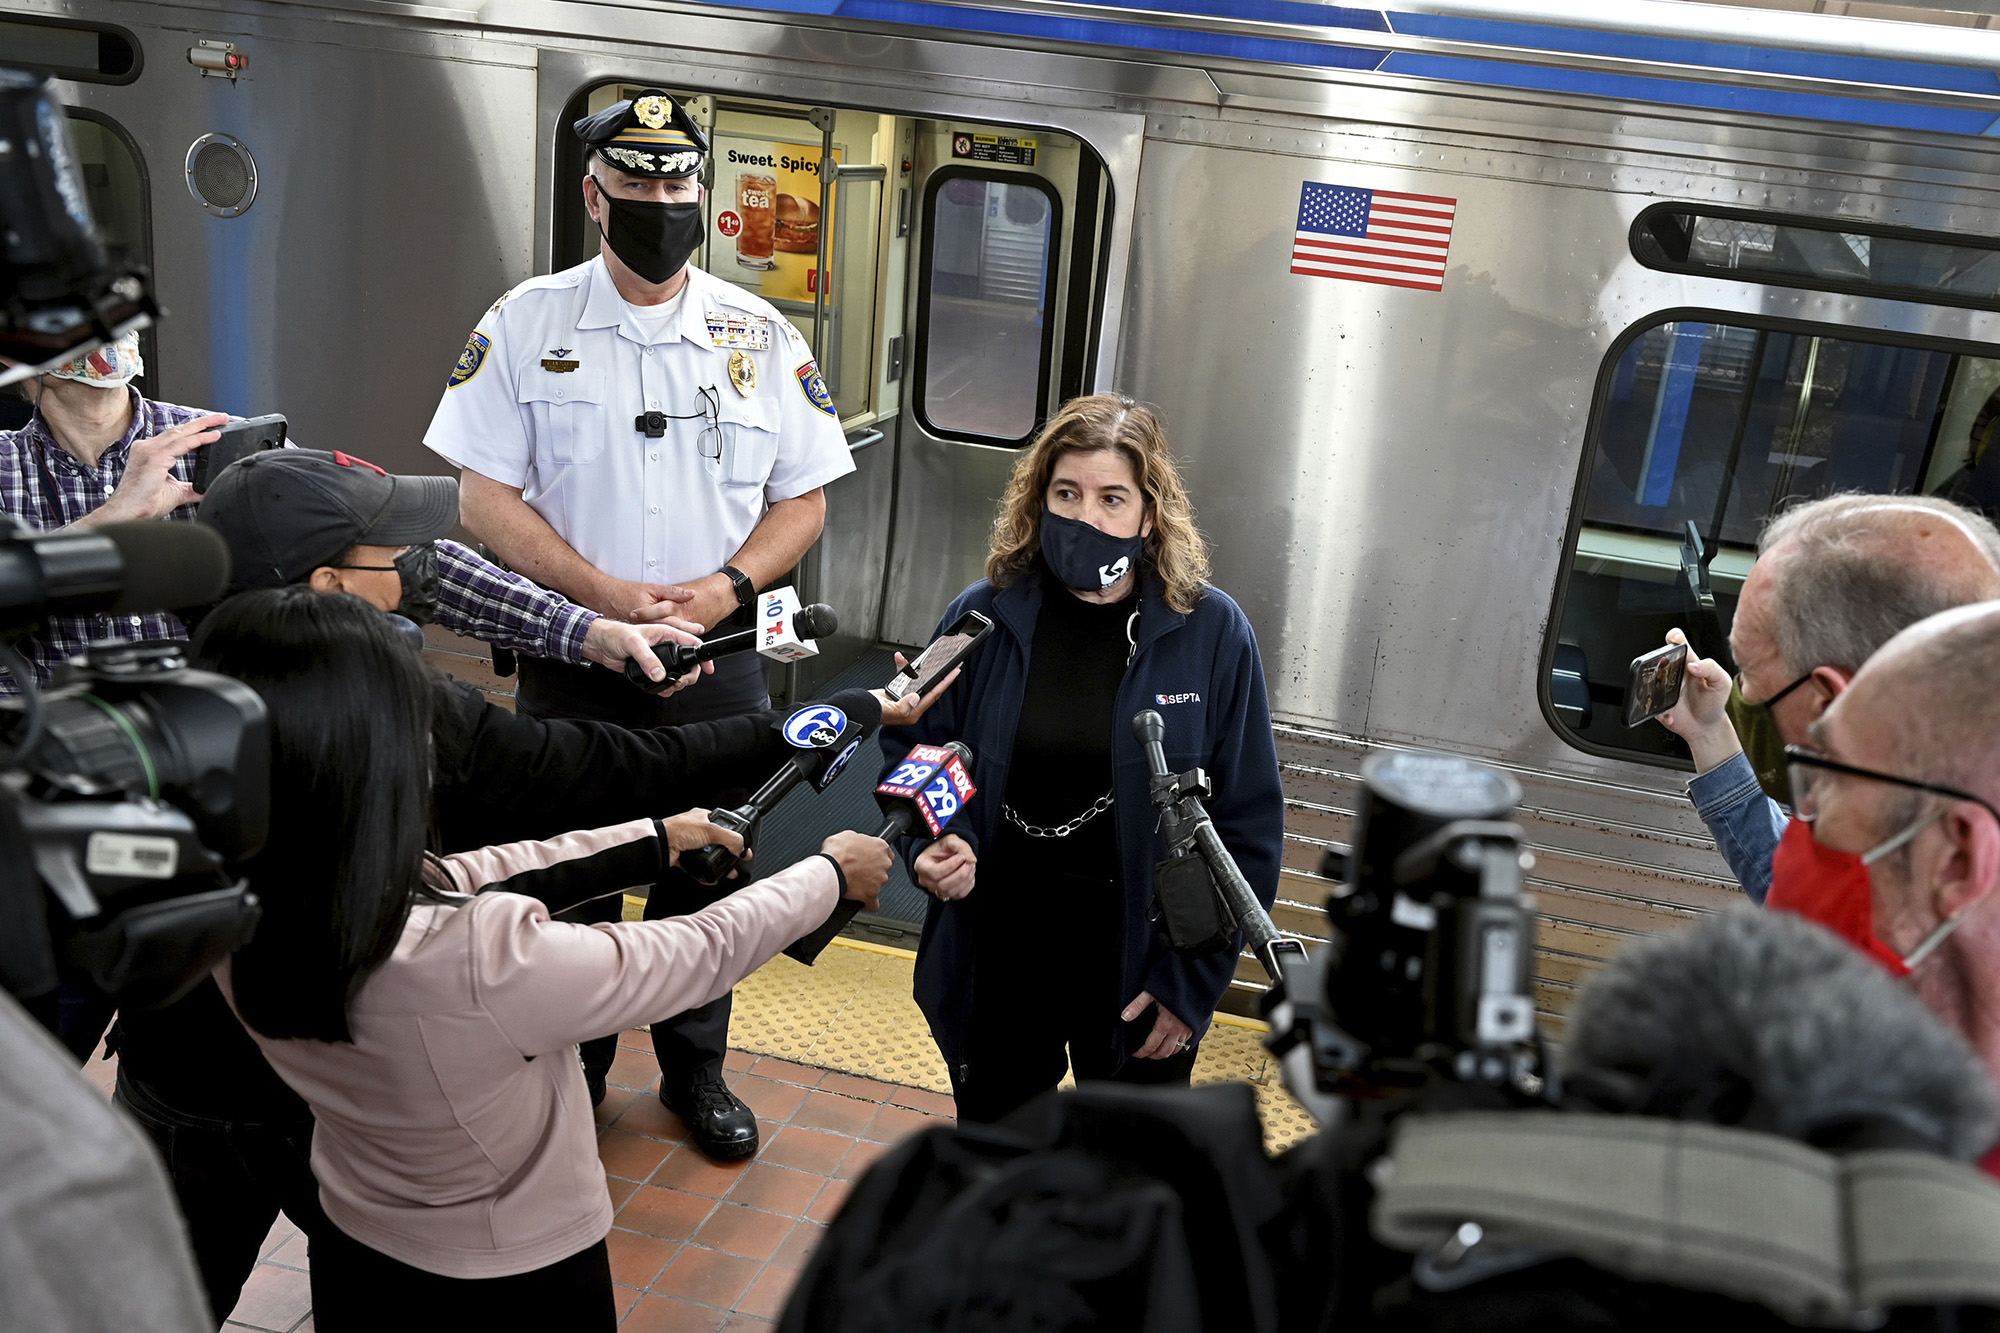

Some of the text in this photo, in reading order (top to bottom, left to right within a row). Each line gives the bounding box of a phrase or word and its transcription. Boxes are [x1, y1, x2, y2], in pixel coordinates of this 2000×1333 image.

[728, 149, 777, 168] Sweet.
[741, 190, 770, 209] tea
[747, 188, 770, 196] sweet
[767, 599, 783, 618] 10
[765, 635, 774, 647] 62
[1168, 692, 1201, 704] SEPTA
[810, 730, 836, 744] abc
[911, 747, 947, 763] FOX
[886, 763, 933, 786] 29
[948, 760, 973, 799] FOX
[879, 784, 914, 795] NEWS
[924, 776, 957, 818] 29
[917, 796, 940, 833] NEWS
